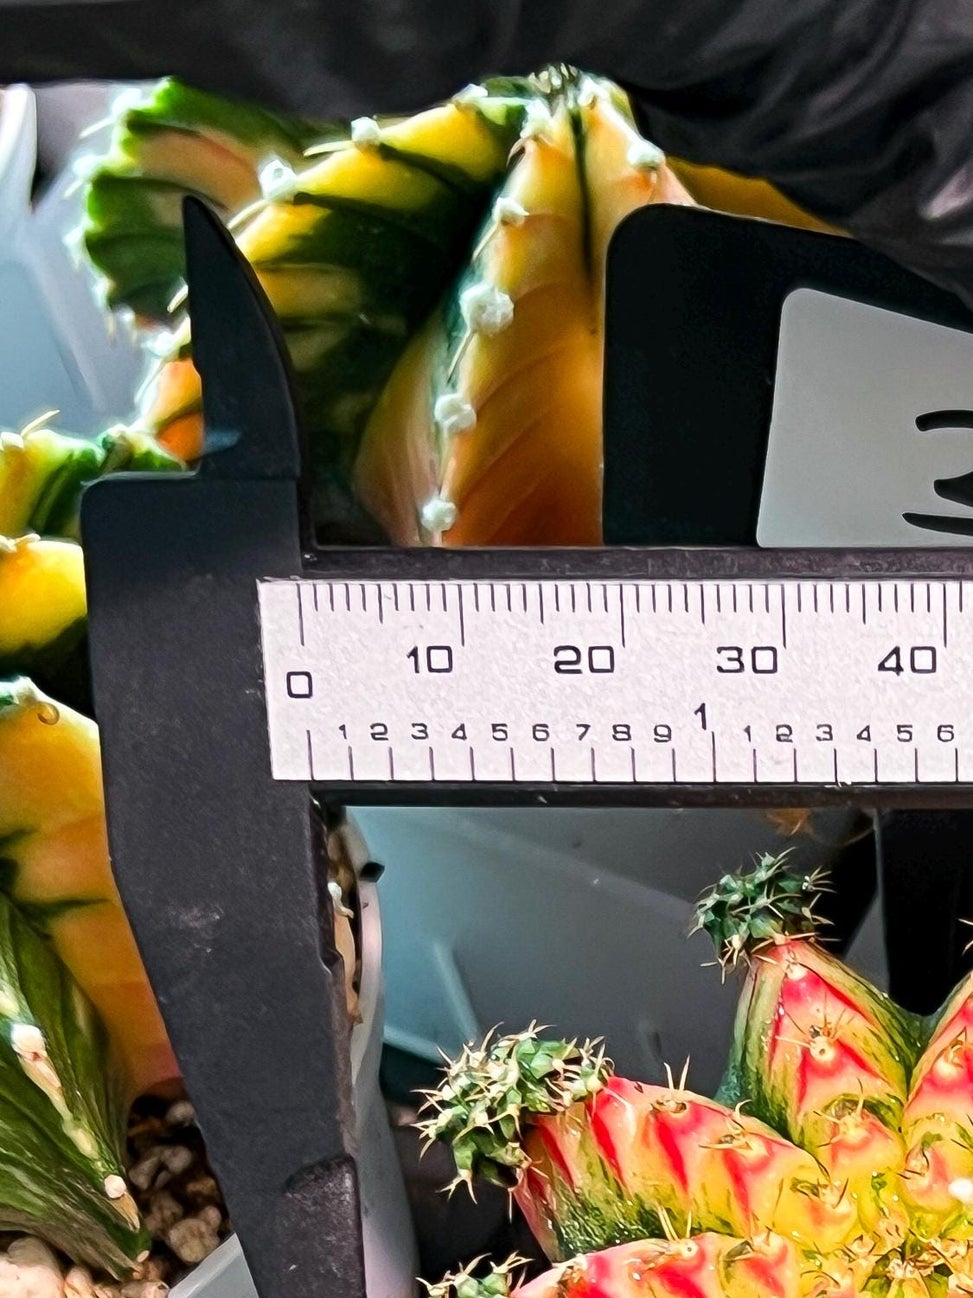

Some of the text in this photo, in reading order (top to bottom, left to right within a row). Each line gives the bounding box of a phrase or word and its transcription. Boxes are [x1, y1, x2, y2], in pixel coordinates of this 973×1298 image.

[286, 671, 313, 699] 0
[406, 645, 454, 675] 10
[553, 645, 615, 675] 20
[716, 645, 779, 675] 30
[877, 645, 938, 676] 40
[338, 724, 347, 740] 1
[369, 722, 389, 741] 2
[411, 722, 429, 740] 3
[451, 723, 468, 741] 4
[491, 723, 508, 742] 5
[532, 723, 550, 742] 6
[576, 723, 591, 741] 7
[612, 723, 632, 742] 8
[653, 724, 672, 743] 9
[694, 701, 708, 732] 1
[744, 725, 752, 742] 1
[775, 724, 793, 743] 2
[815, 723, 834, 742] 3
[856, 725, 872, 742] 4
[896, 724, 913, 743] 5
[937, 724, 955, 743] 6
